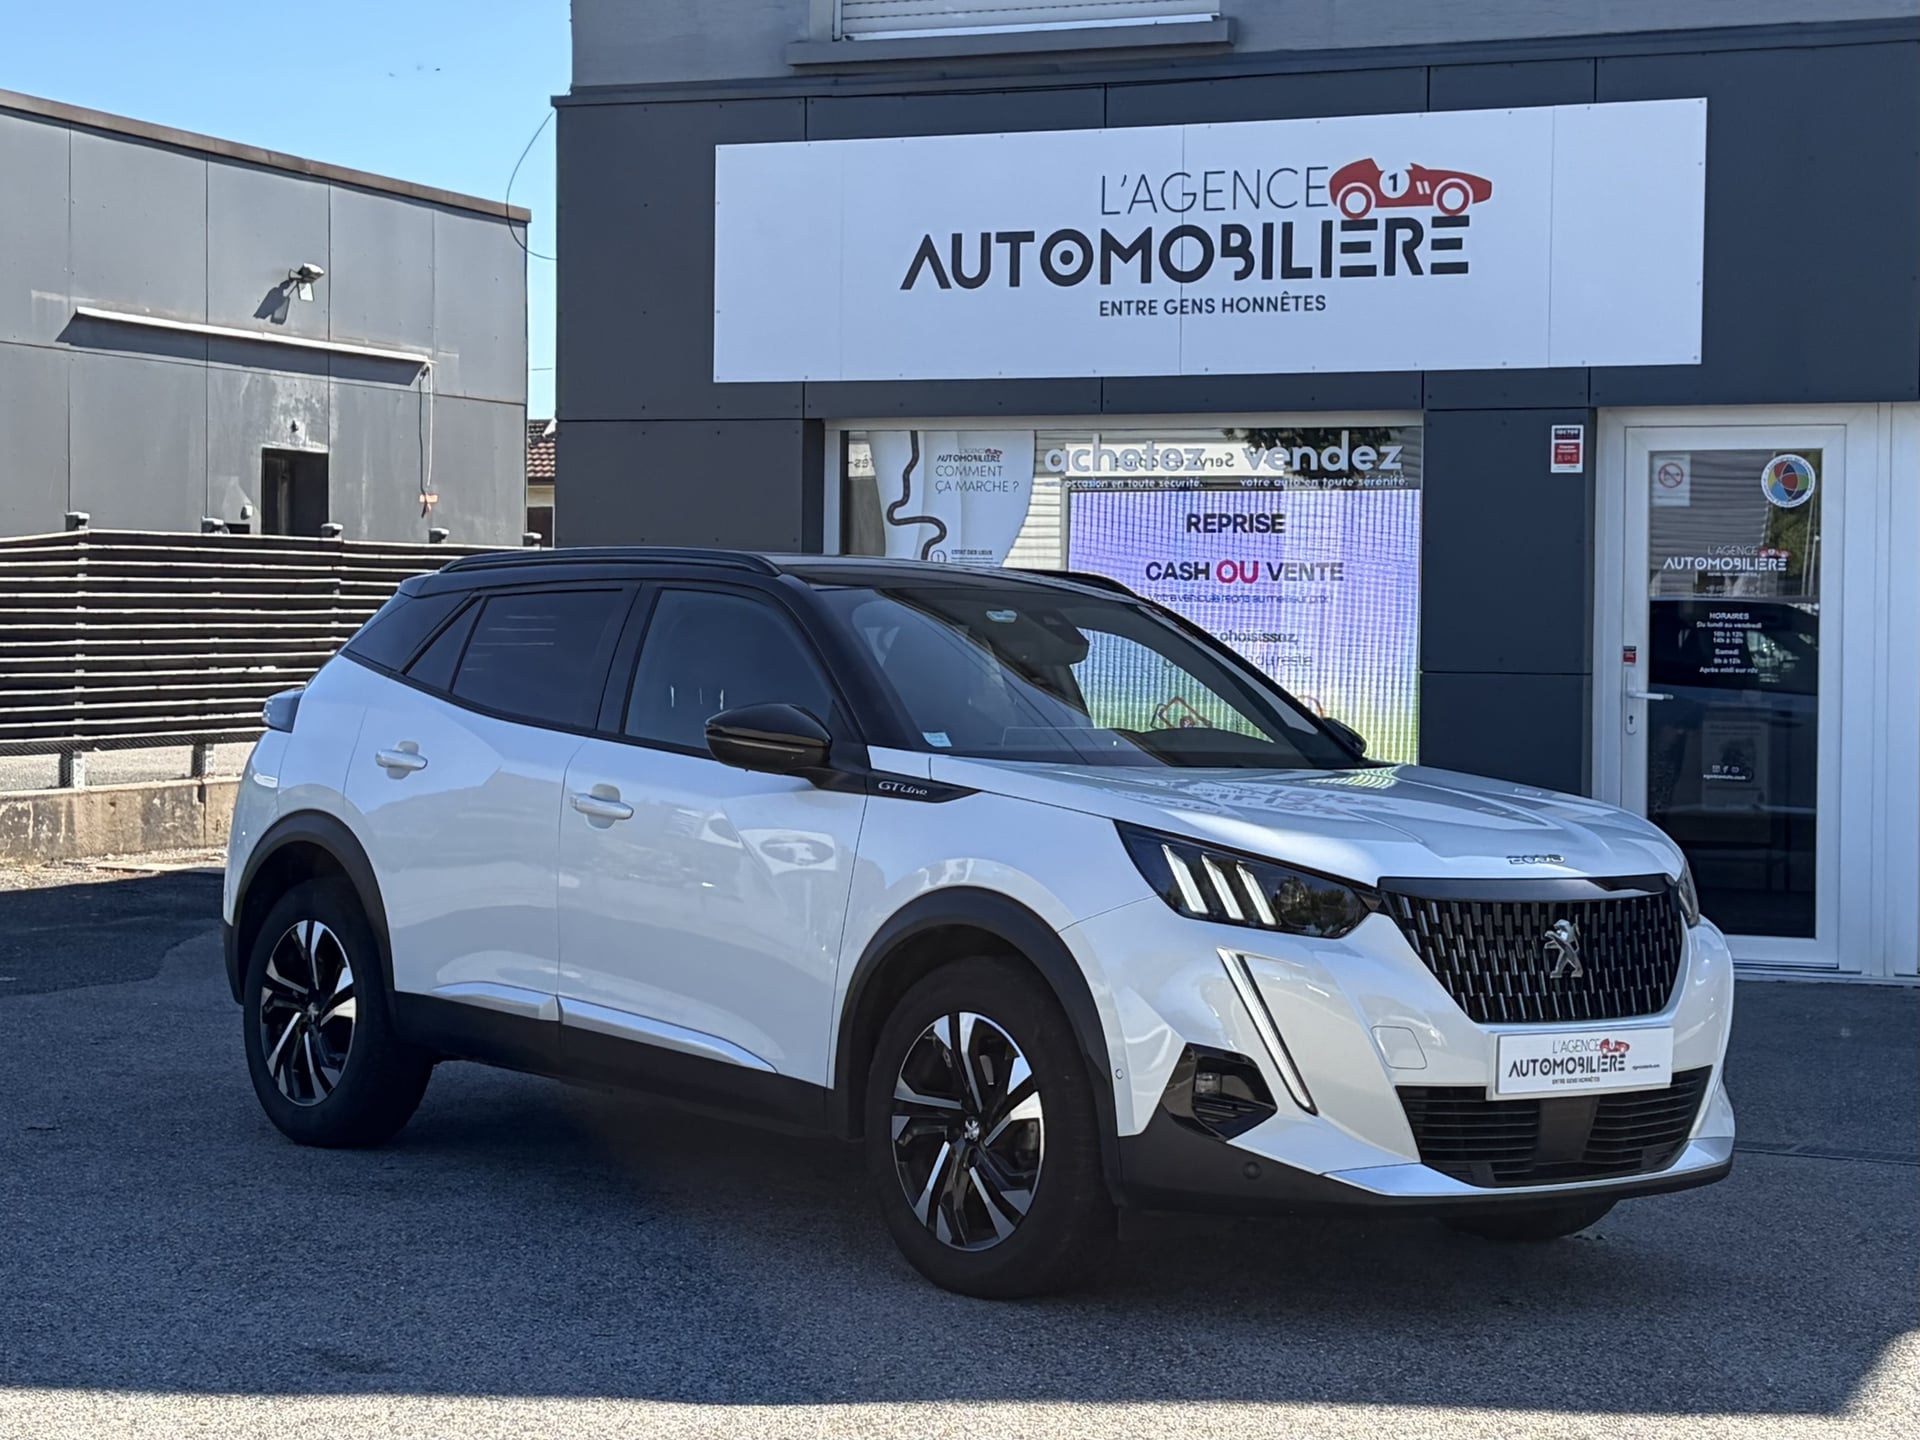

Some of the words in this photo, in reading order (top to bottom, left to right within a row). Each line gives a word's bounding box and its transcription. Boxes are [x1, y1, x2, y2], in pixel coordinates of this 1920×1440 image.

[1102, 166, 1329, 215] L'AGENCE
[1388, 173, 1399, 192] 1
[1100, 299, 1158, 317] ENTRE
[1164, 298, 1215, 316] GENS
[1222, 290, 1326, 314] HONNÊTES
[1044, 433, 1206, 472] achetez
[1242, 430, 1404, 472] vendez
[936, 465, 1003, 477] COMMENT
[935, 480, 952, 494] ÇA
[955, 480, 1009, 492] MARCHE
[1013, 481, 1020, 492] ?
[1064, 477, 1109, 488] occasion
[1111, 480, 1124, 488] en
[1128, 478, 1156, 488] toute
[1240, 476, 1270, 487] votre
[1274, 476, 1303, 487] auto
[1322, 476, 1354, 487] toute
[1186, 513, 1287, 534] REPRISE
[1146, 561, 1211, 582] CASH
[1216, 559, 1260, 584] OU
[1267, 561, 1345, 582] VENTE
[878, 780, 901, 791] GT
[901, 784, 928, 796] Line
[1552, 1038, 1601, 1054] L'AGENCE
